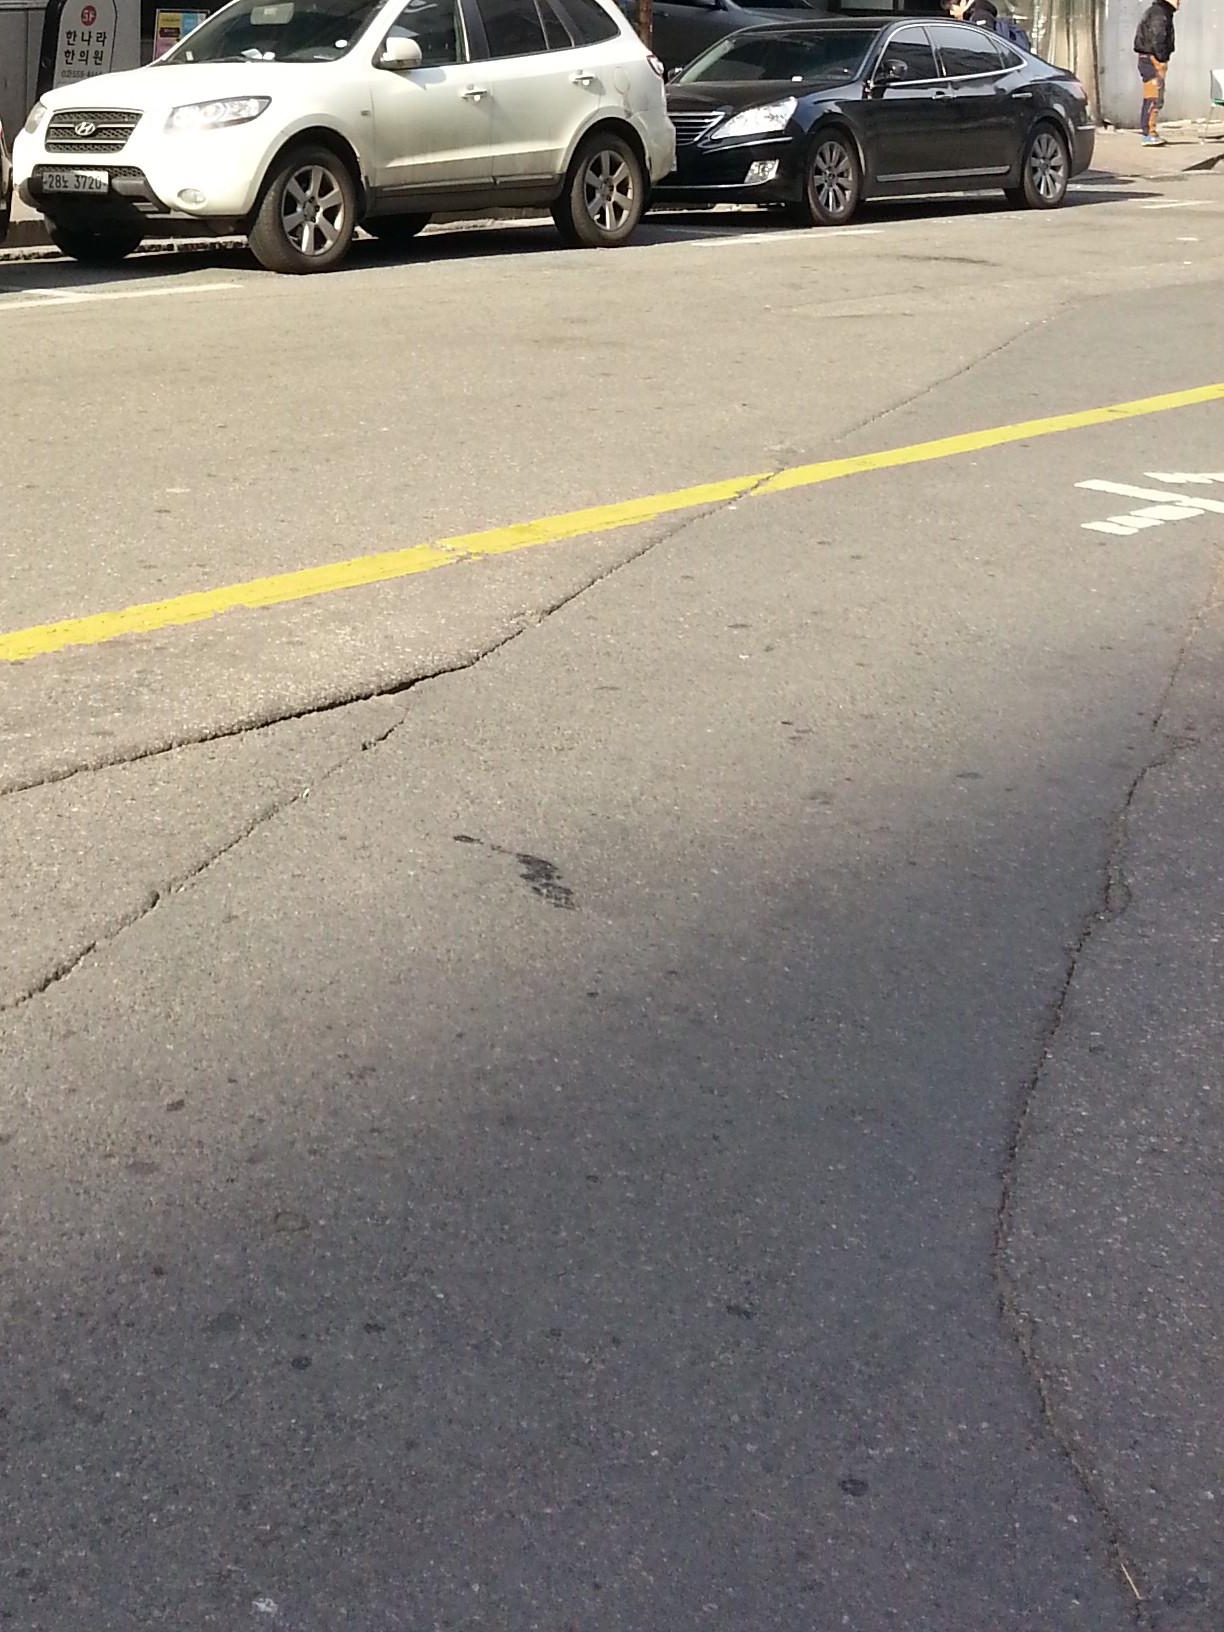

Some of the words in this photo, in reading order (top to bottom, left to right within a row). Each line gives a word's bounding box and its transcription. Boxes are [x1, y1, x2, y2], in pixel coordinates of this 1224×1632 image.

[66, 30, 107, 47] 한나라
[64, 49, 104, 66] 한의원
[48, 174, 69, 189] 28노
[74, 174, 102, 190] 3720
